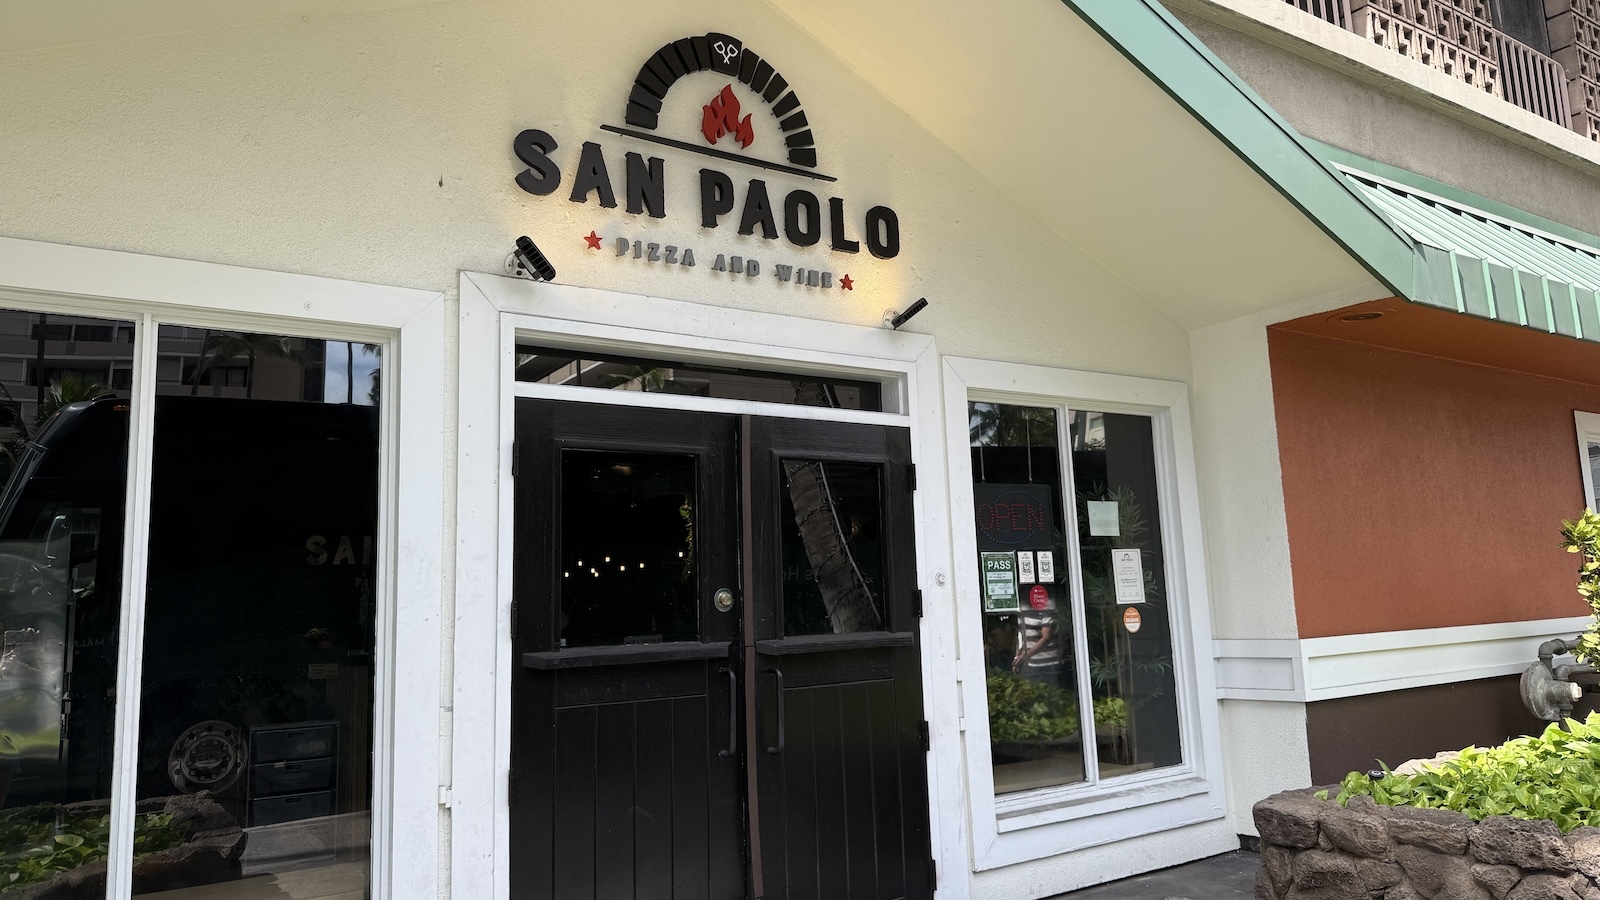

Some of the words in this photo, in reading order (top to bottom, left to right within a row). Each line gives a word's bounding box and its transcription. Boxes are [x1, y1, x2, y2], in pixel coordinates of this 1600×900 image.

[513, 129, 667, 218] SAN
[699, 168, 901, 259] PAOLO
[615, 237, 696, 267] PIZZA
[711, 253, 760, 278] AND
[775, 264, 834, 289] WINE
[977, 503, 1044, 531] OPEN
[987, 560, 1012, 570] PASS
